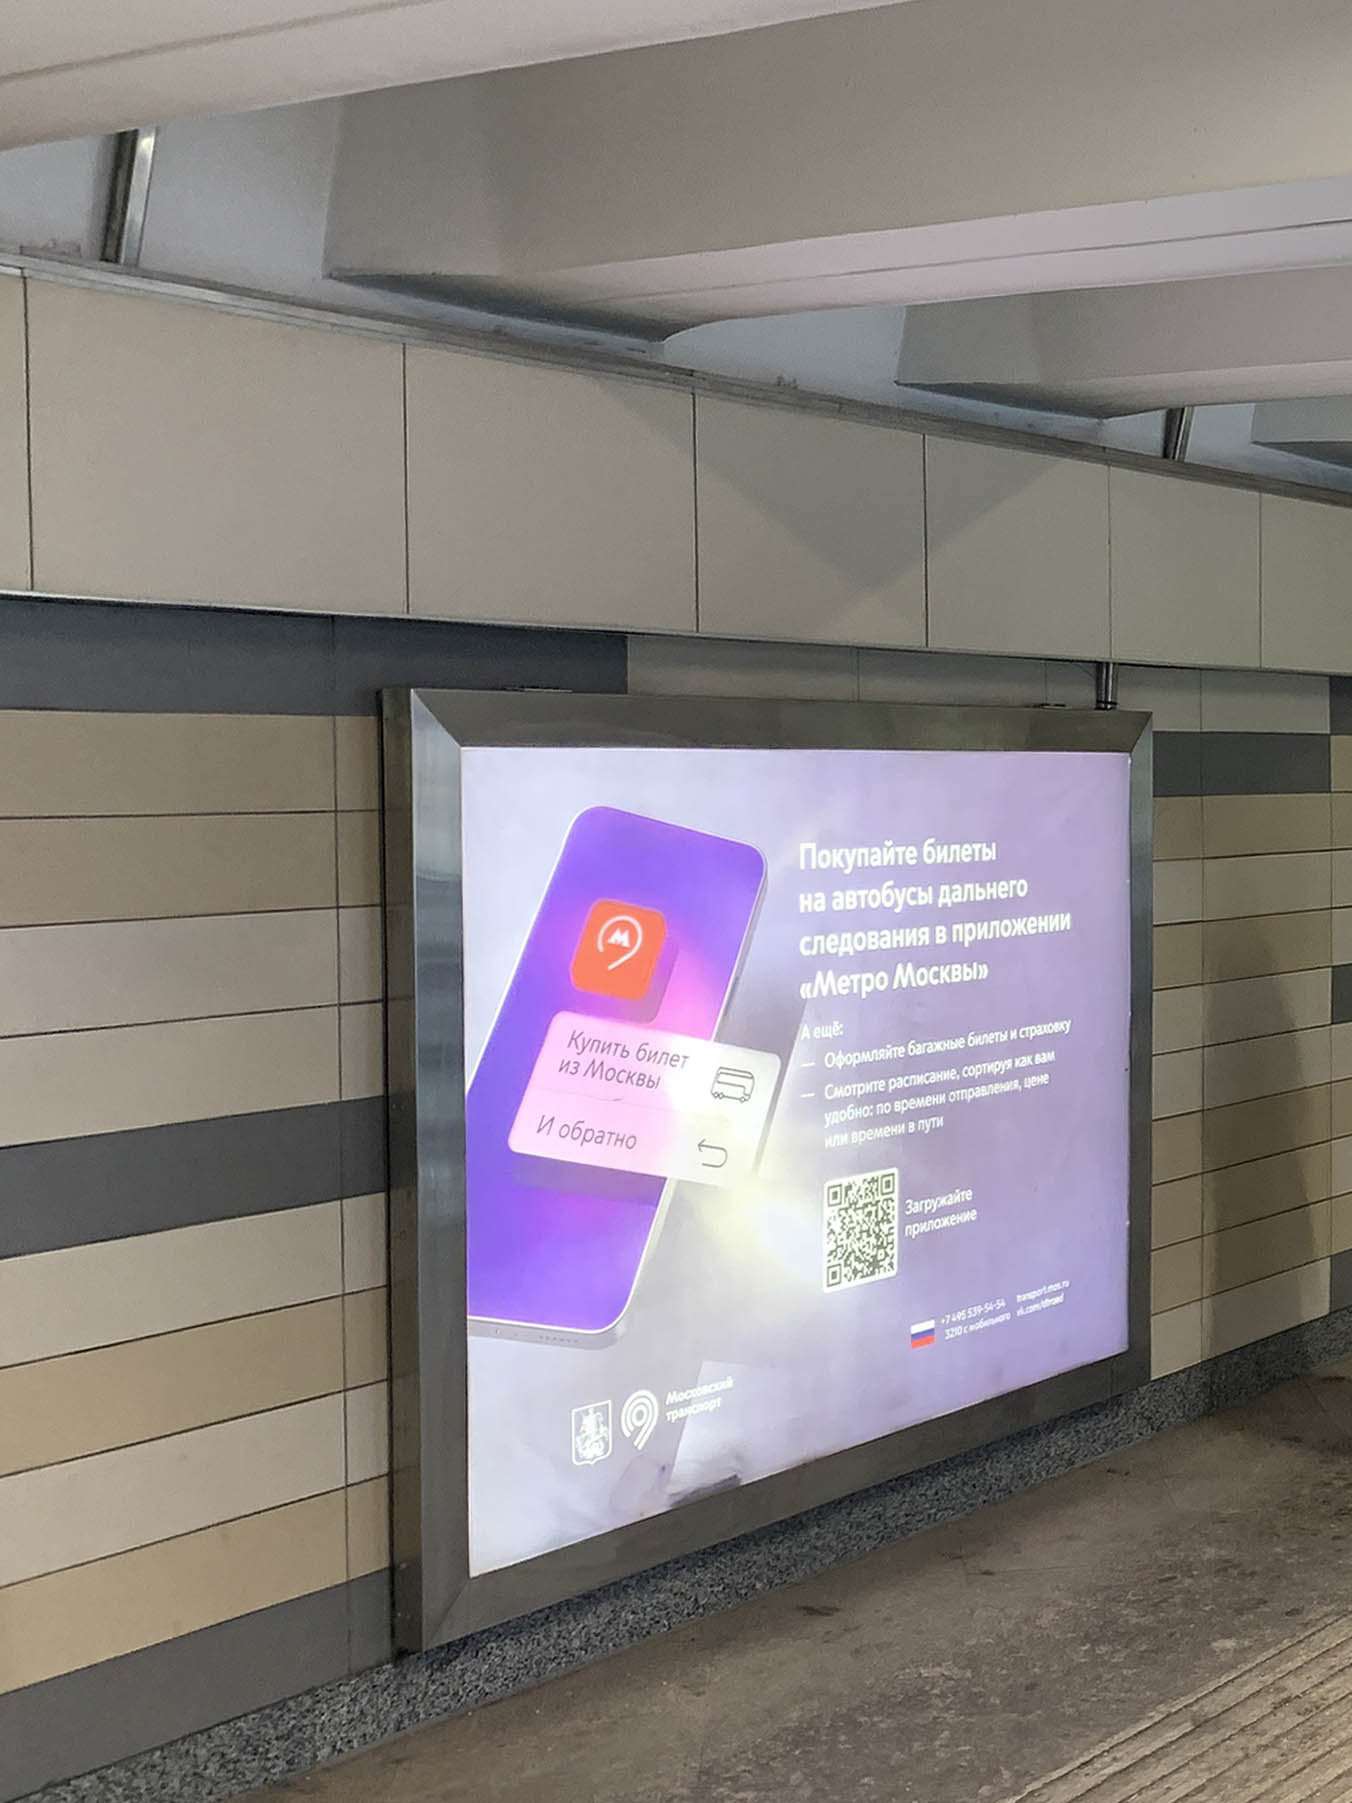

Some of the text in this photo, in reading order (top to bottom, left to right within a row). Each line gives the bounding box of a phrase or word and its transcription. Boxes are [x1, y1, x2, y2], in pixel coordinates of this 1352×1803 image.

[800, 838, 996, 874] Покупайте билеты
[800, 878, 1028, 912] на автобусы дальнего
[800, 912, 1071, 957] следования в приложении
[800, 960, 988, 1000] «Метро Москвы»
[801, 1020, 844, 1040] А ещё:
[824, 1018, 1071, 1070] Оформляйте багажные билеты и страховку
[567, 1030, 690, 1069] Купить билет
[558, 1059, 661, 1089] из Москвы
[824, 1050, 1056, 1102] Смотрите расписание, сортируя как вам
[824, 1072, 1050, 1128] удобно: по времени отправления, цене
[536, 1114, 637, 1150] И обратно
[824, 1114, 944, 1149] или времени в пути
[905, 1187, 972, 1215] Загружайте
[905, 1206, 977, 1239] приложение
[941, 1314, 950, 1324] +7
[952, 1310, 966, 1322] 495
[665, 1376, 734, 1405] Московский
[667, 1397, 722, 1423] транспорт
